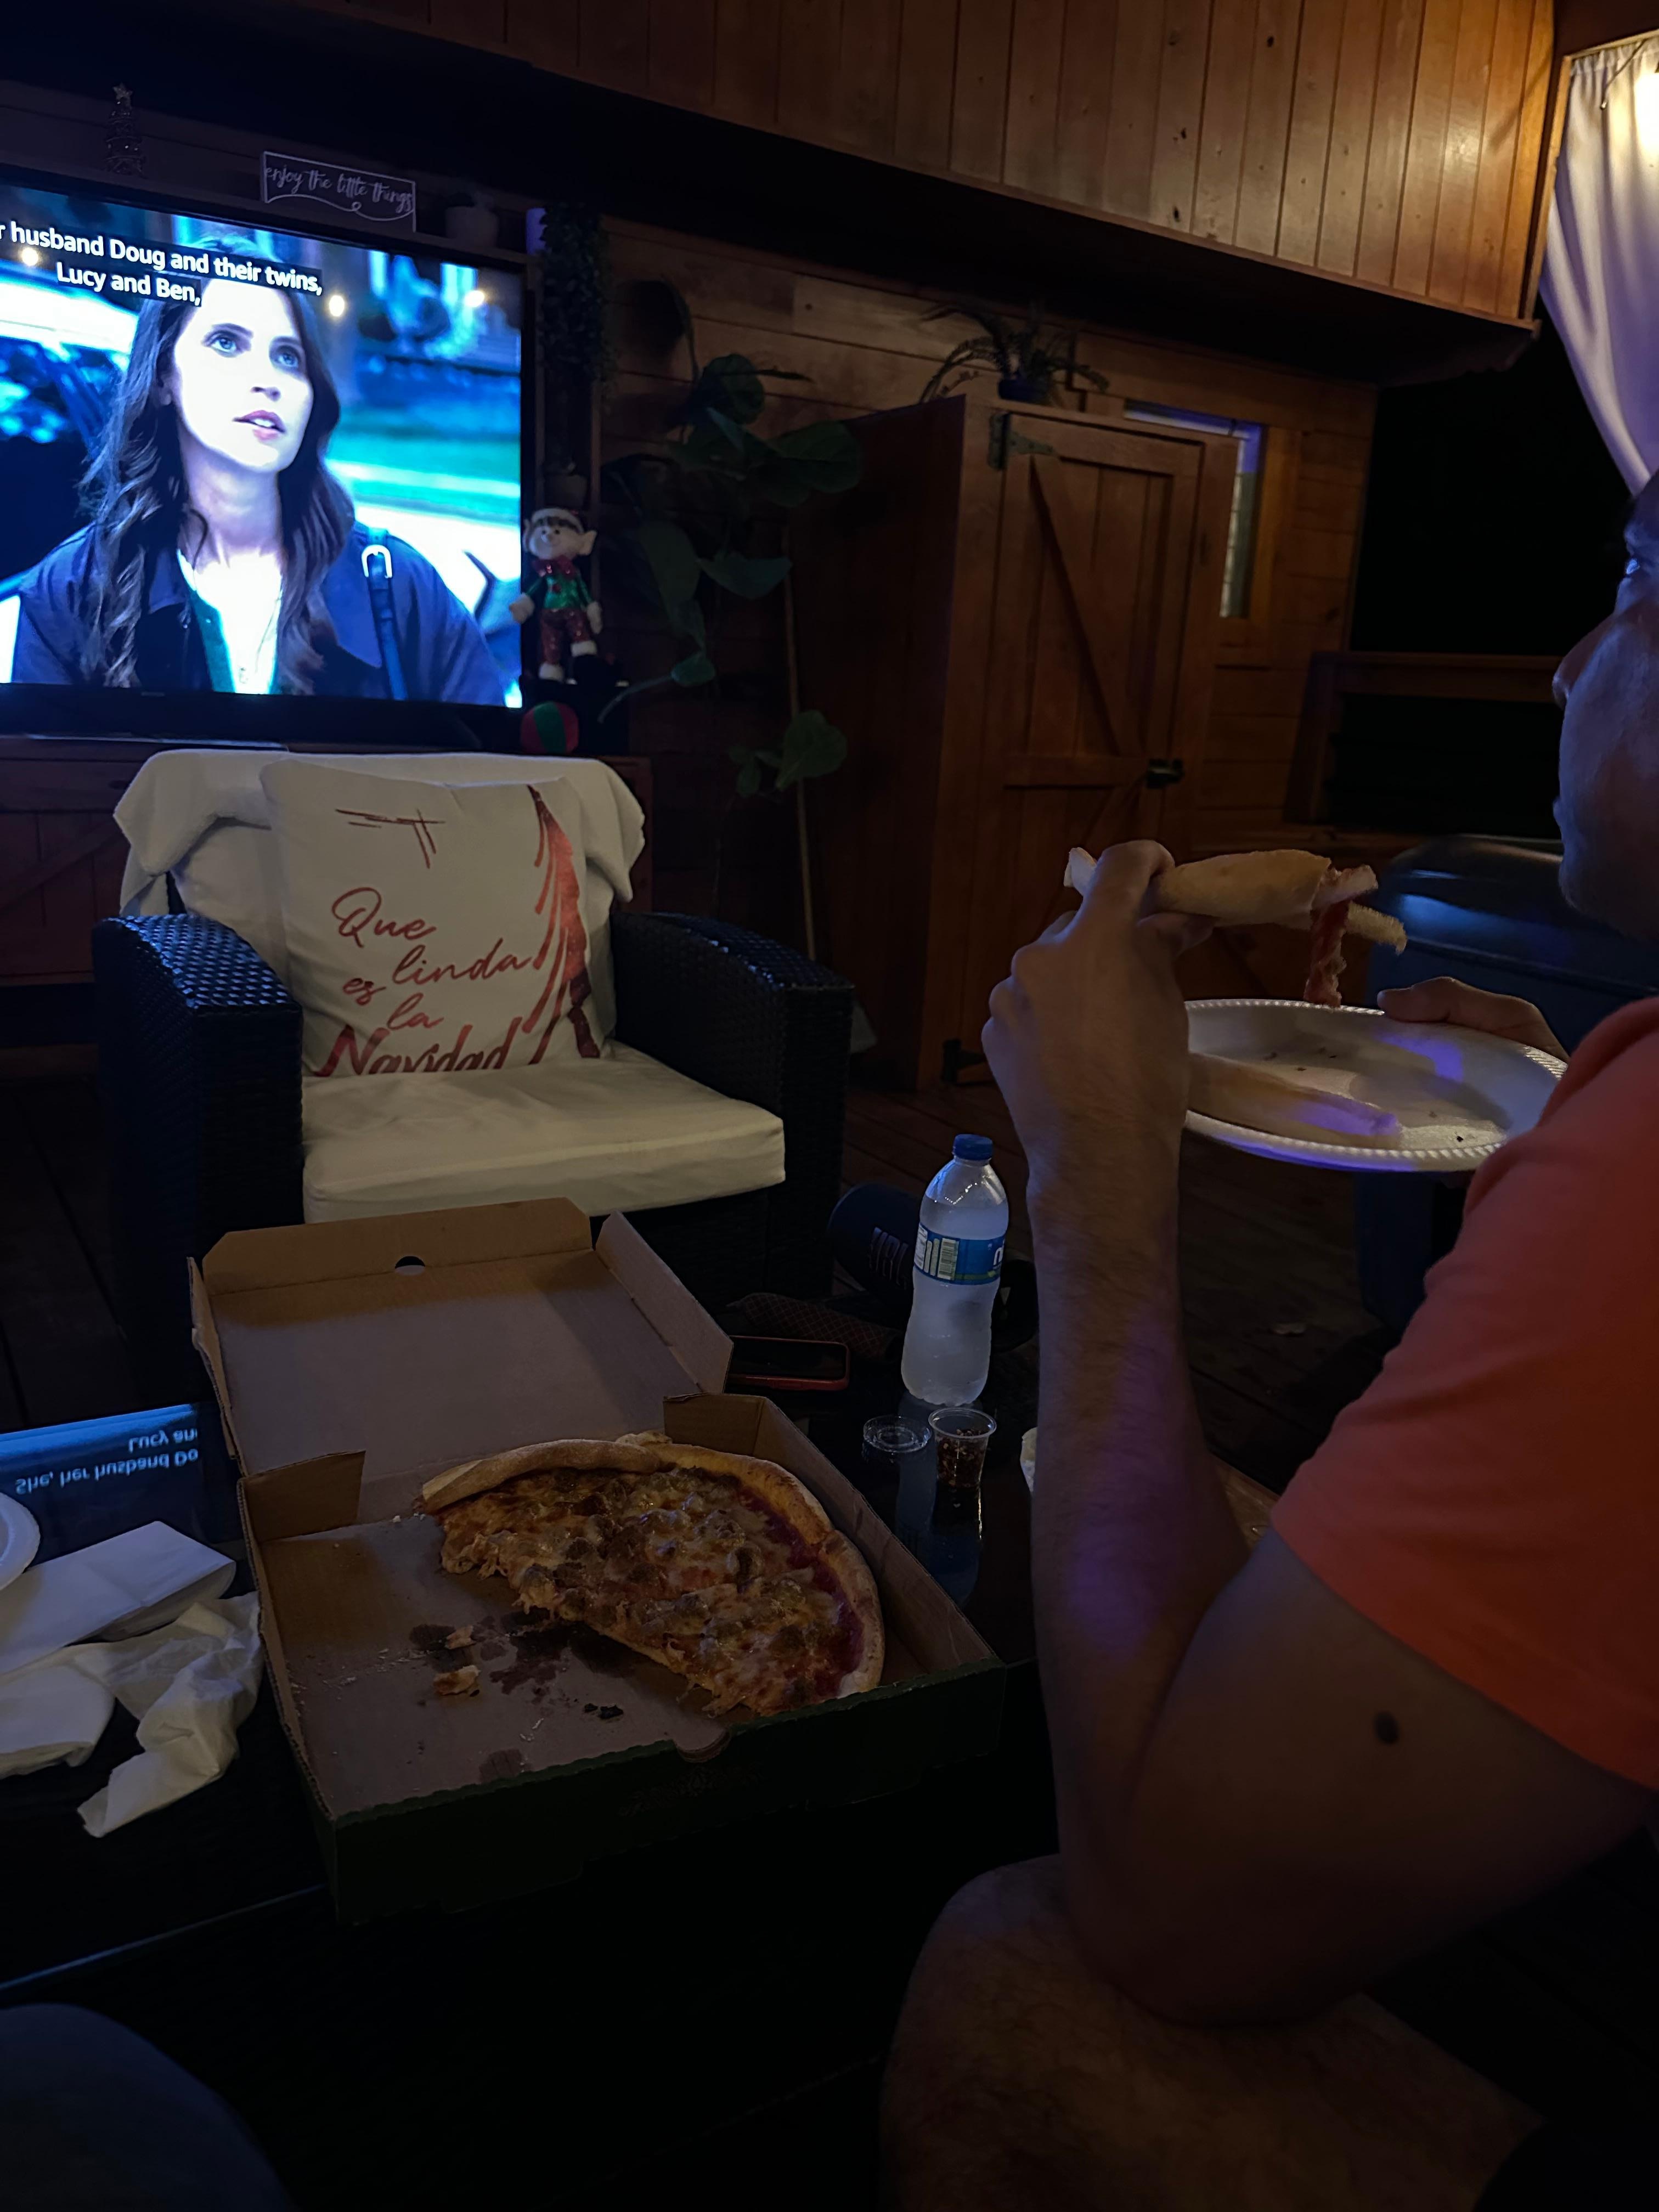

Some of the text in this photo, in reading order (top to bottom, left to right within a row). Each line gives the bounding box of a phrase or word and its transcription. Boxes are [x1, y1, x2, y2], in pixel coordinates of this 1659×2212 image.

[303, 169, 332, 191] the
[11, 221, 104, 257] husband
[110, 238, 165, 270] Doug
[170, 253, 209, 274] and
[213, 257, 261, 283] their
[264, 267, 323, 296] twins,
[57, 262, 201, 306] Lucy and Ben,
[331, 887, 437, 948] Que
[392, 938, 532, 985] linda
[342, 977, 387, 1006] es
[387, 993, 444, 1031] la
